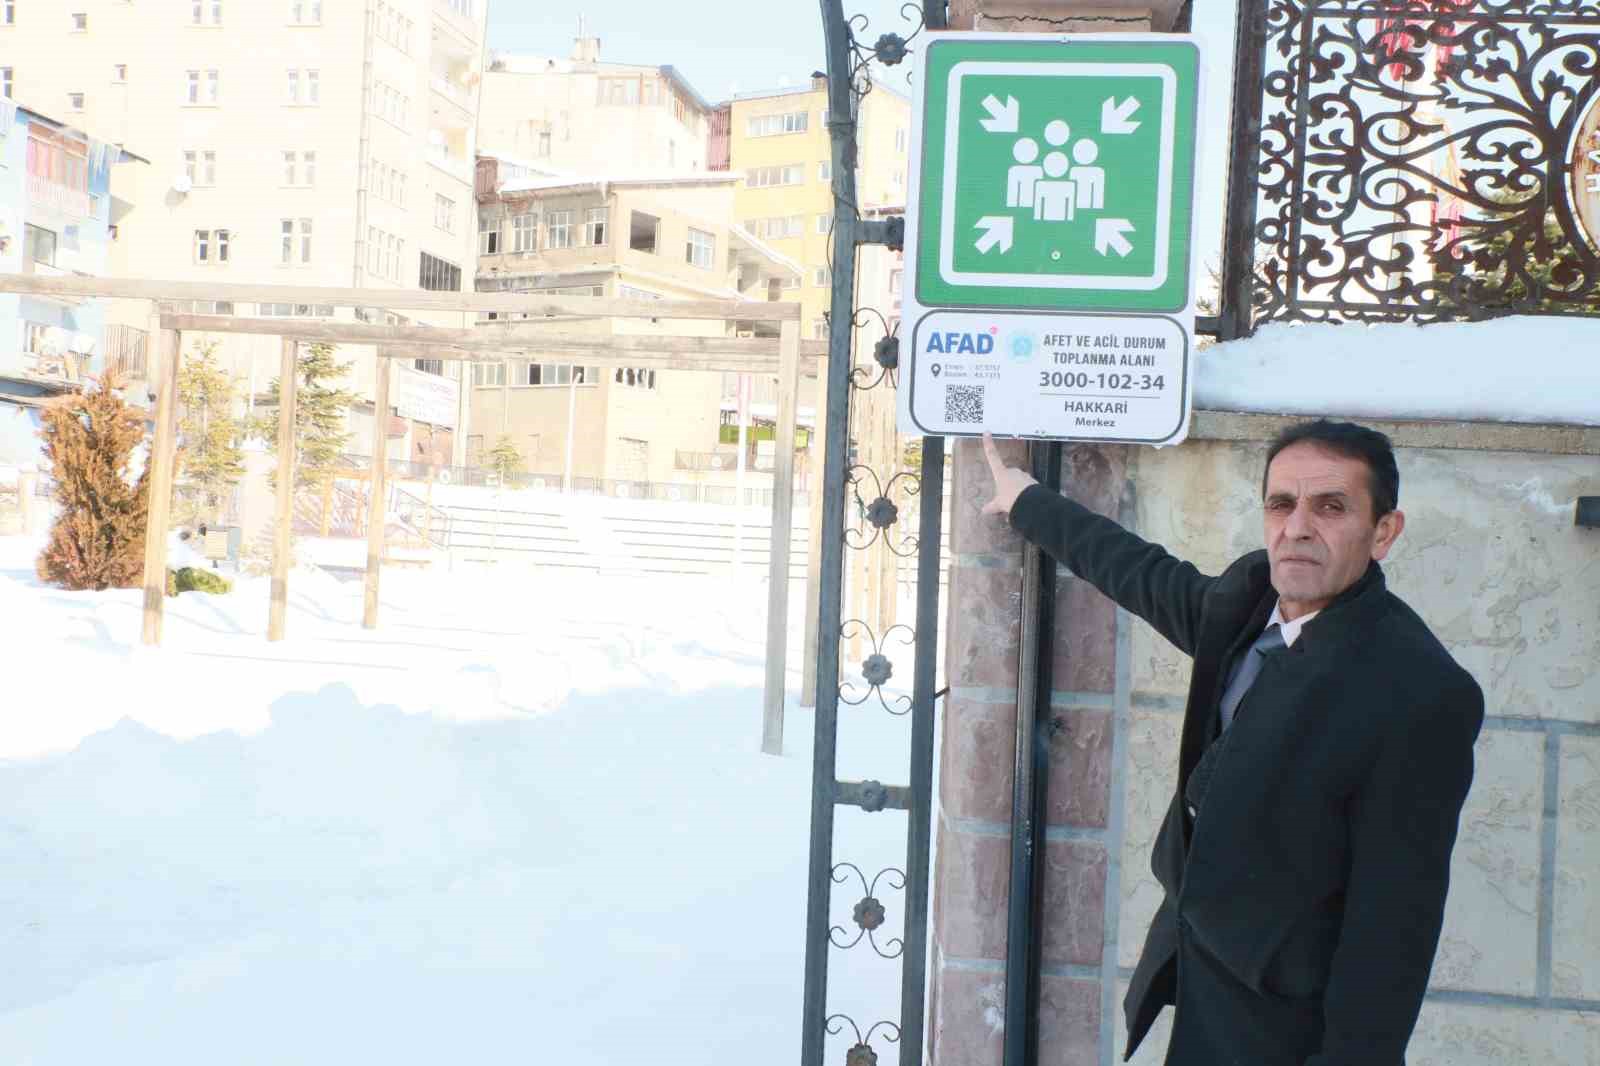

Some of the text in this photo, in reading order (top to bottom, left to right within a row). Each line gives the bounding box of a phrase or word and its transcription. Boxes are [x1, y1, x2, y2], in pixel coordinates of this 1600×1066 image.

[926, 332, 994, 355] AFAD
[1043, 333, 1166, 350] AFET VE ACİL DURUM
[1053, 352, 1155, 367] TOPLANMA ALANI
[1039, 371, 1165, 391] 3000-102-34
[1064, 400, 1128, 414] HAKKARİ
[1075, 417, 1116, 427] Merkez
